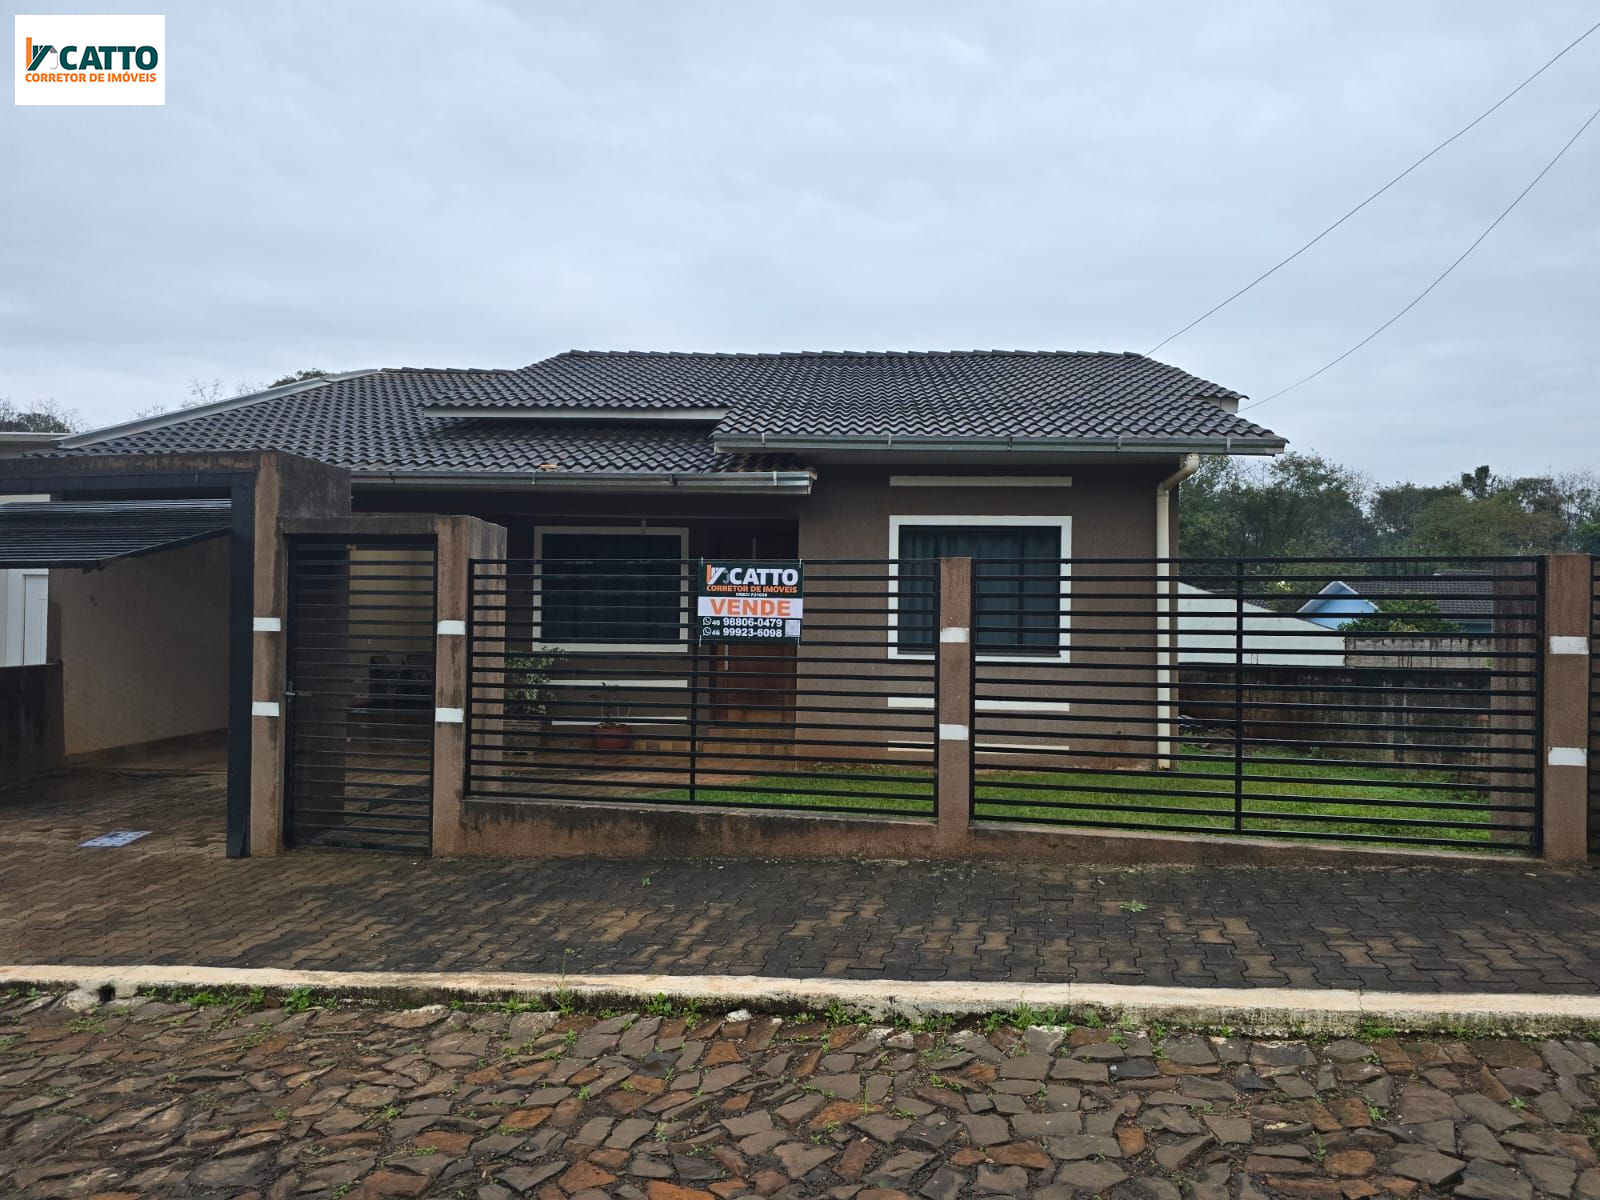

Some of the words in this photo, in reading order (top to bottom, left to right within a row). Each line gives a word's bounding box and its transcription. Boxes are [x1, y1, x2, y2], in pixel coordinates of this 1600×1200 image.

[729, 568, 799, 586] CATTO
[709, 598, 791, 617] VENDE
[722, 617, 783, 627] 98806-0479
[722, 627, 783, 637] 99923-6098
